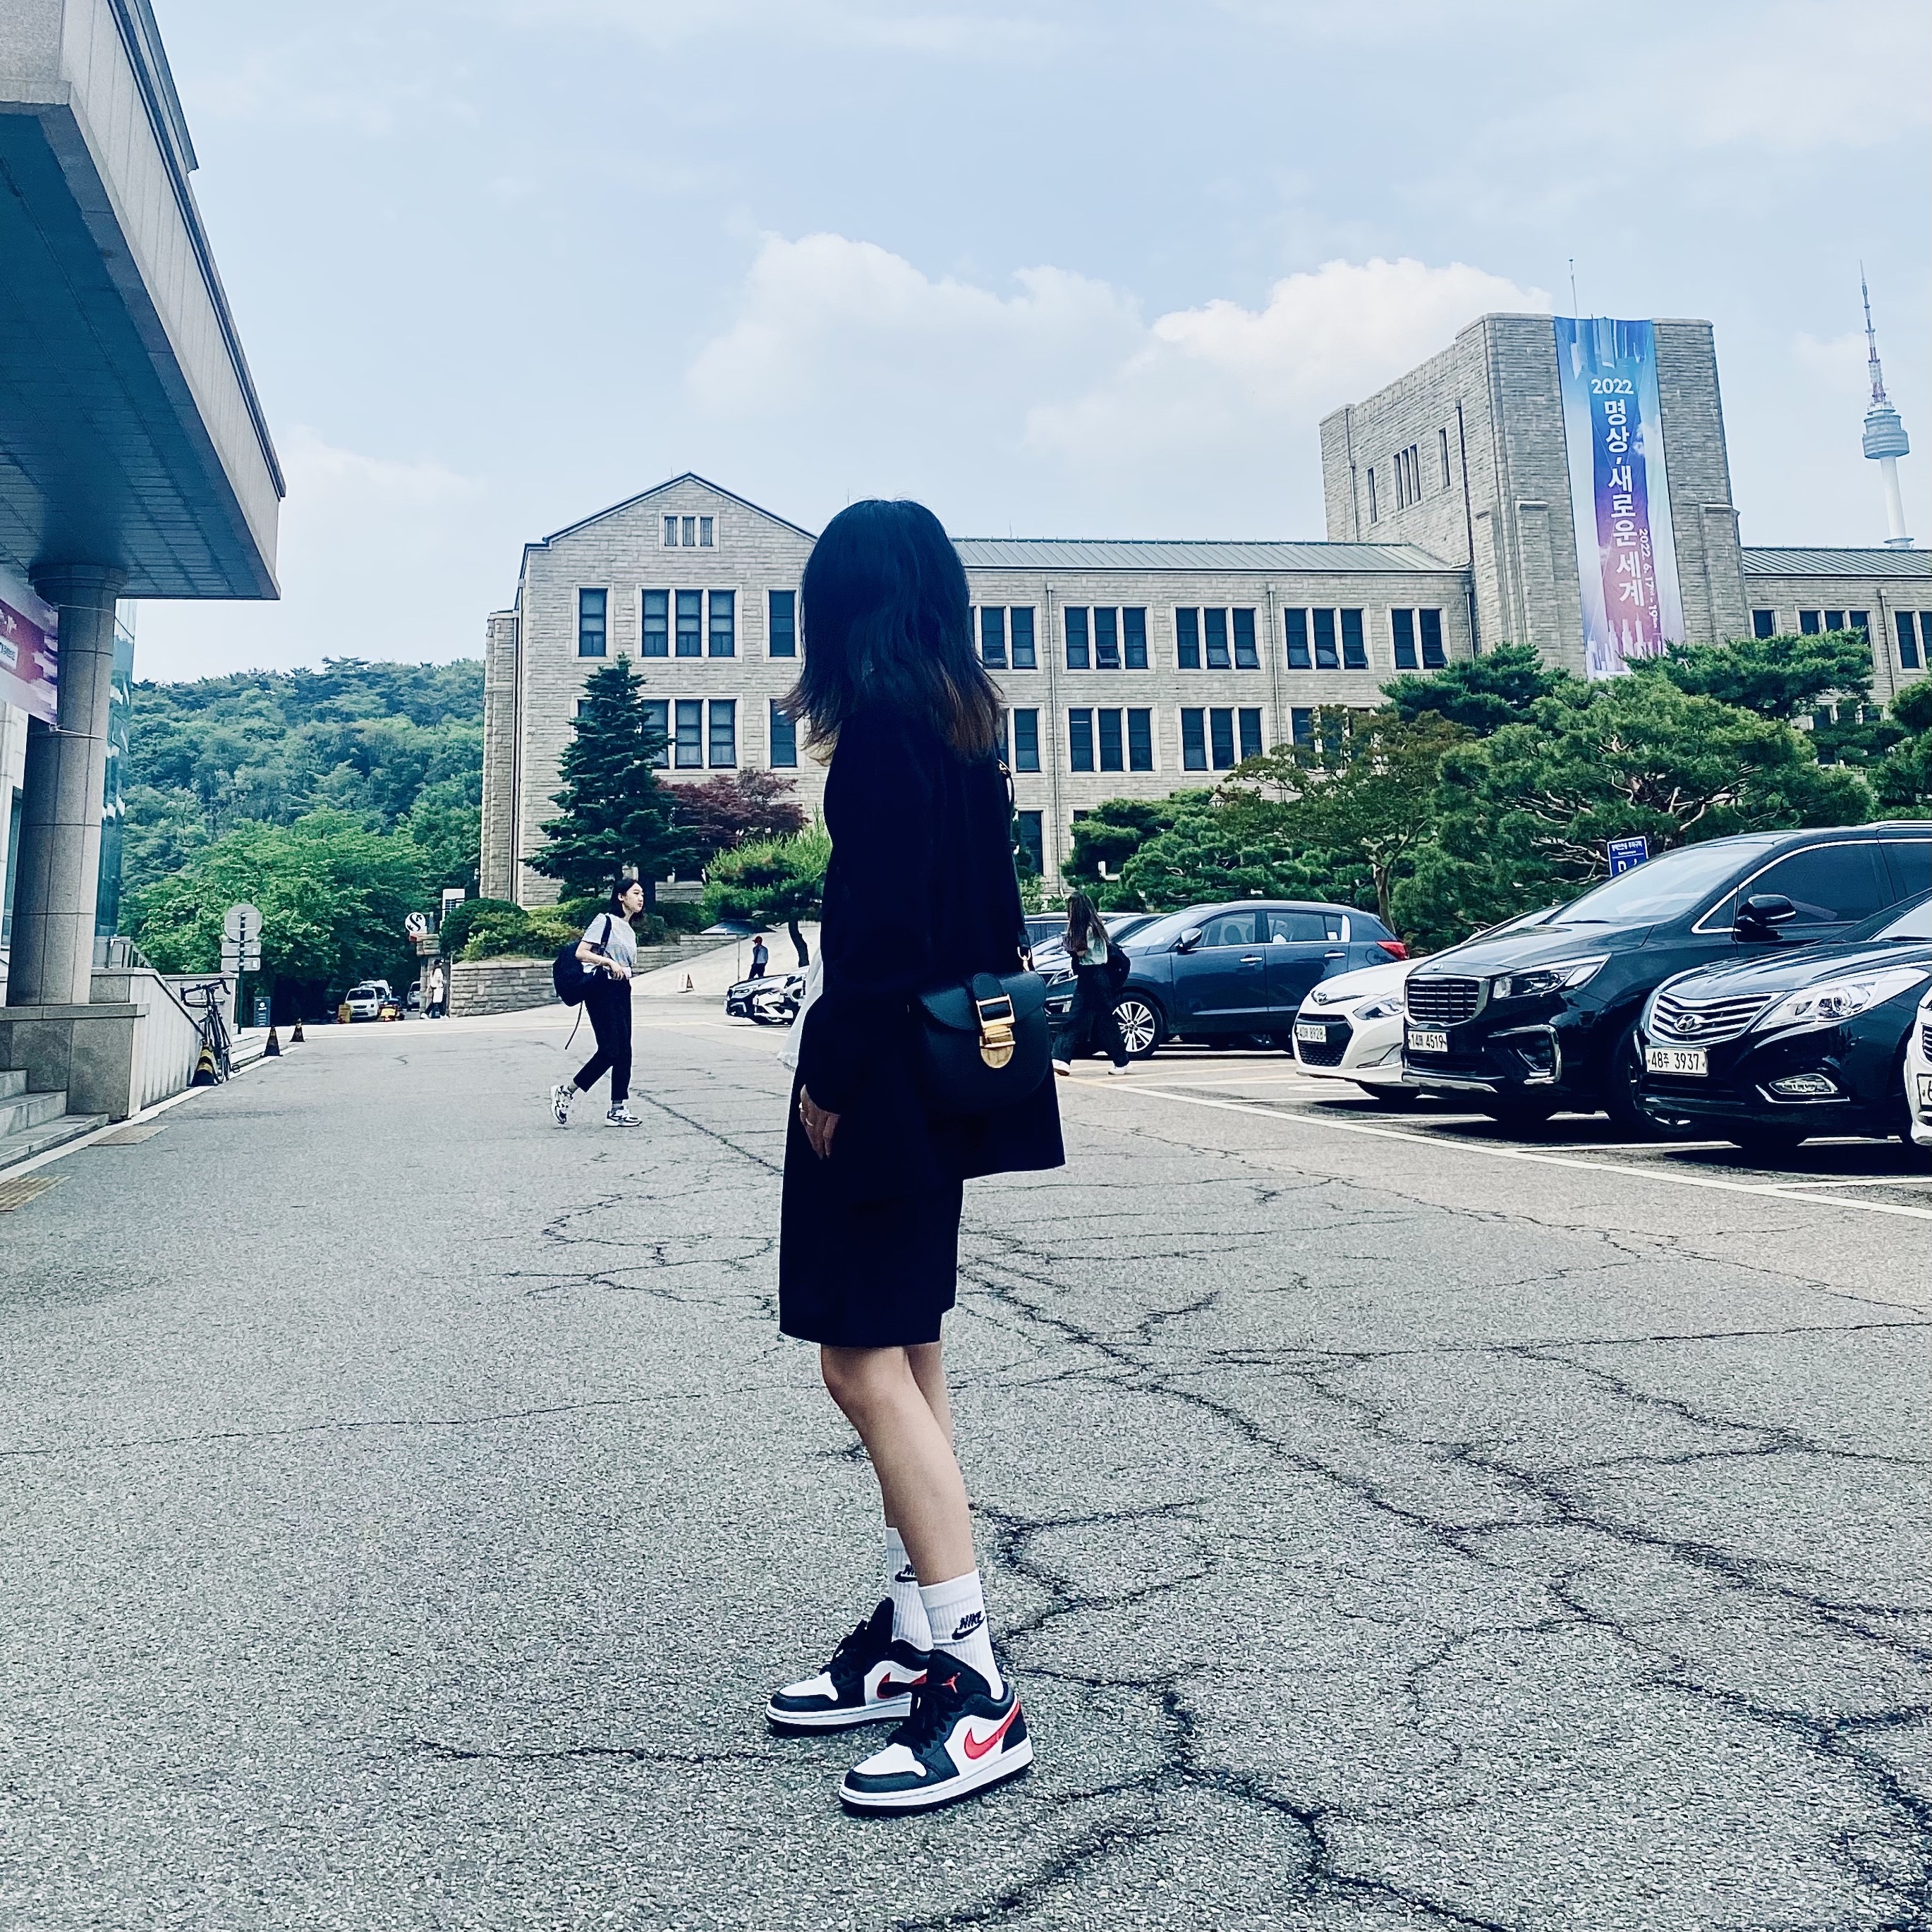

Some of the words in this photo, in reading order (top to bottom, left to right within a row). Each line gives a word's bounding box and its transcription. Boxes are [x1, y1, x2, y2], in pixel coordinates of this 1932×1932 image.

[1591, 377, 1634, 394] 2022
[1608, 465, 1637, 547] 새로운
[1616, 550, 1645, 607] 세계
[1426, 1034, 1444, 1049] 4519
[1651, 1051, 1670, 1069] 48주
[1674, 1052, 1699, 1071] 3937
[959, 1610, 983, 1630] NIKE
